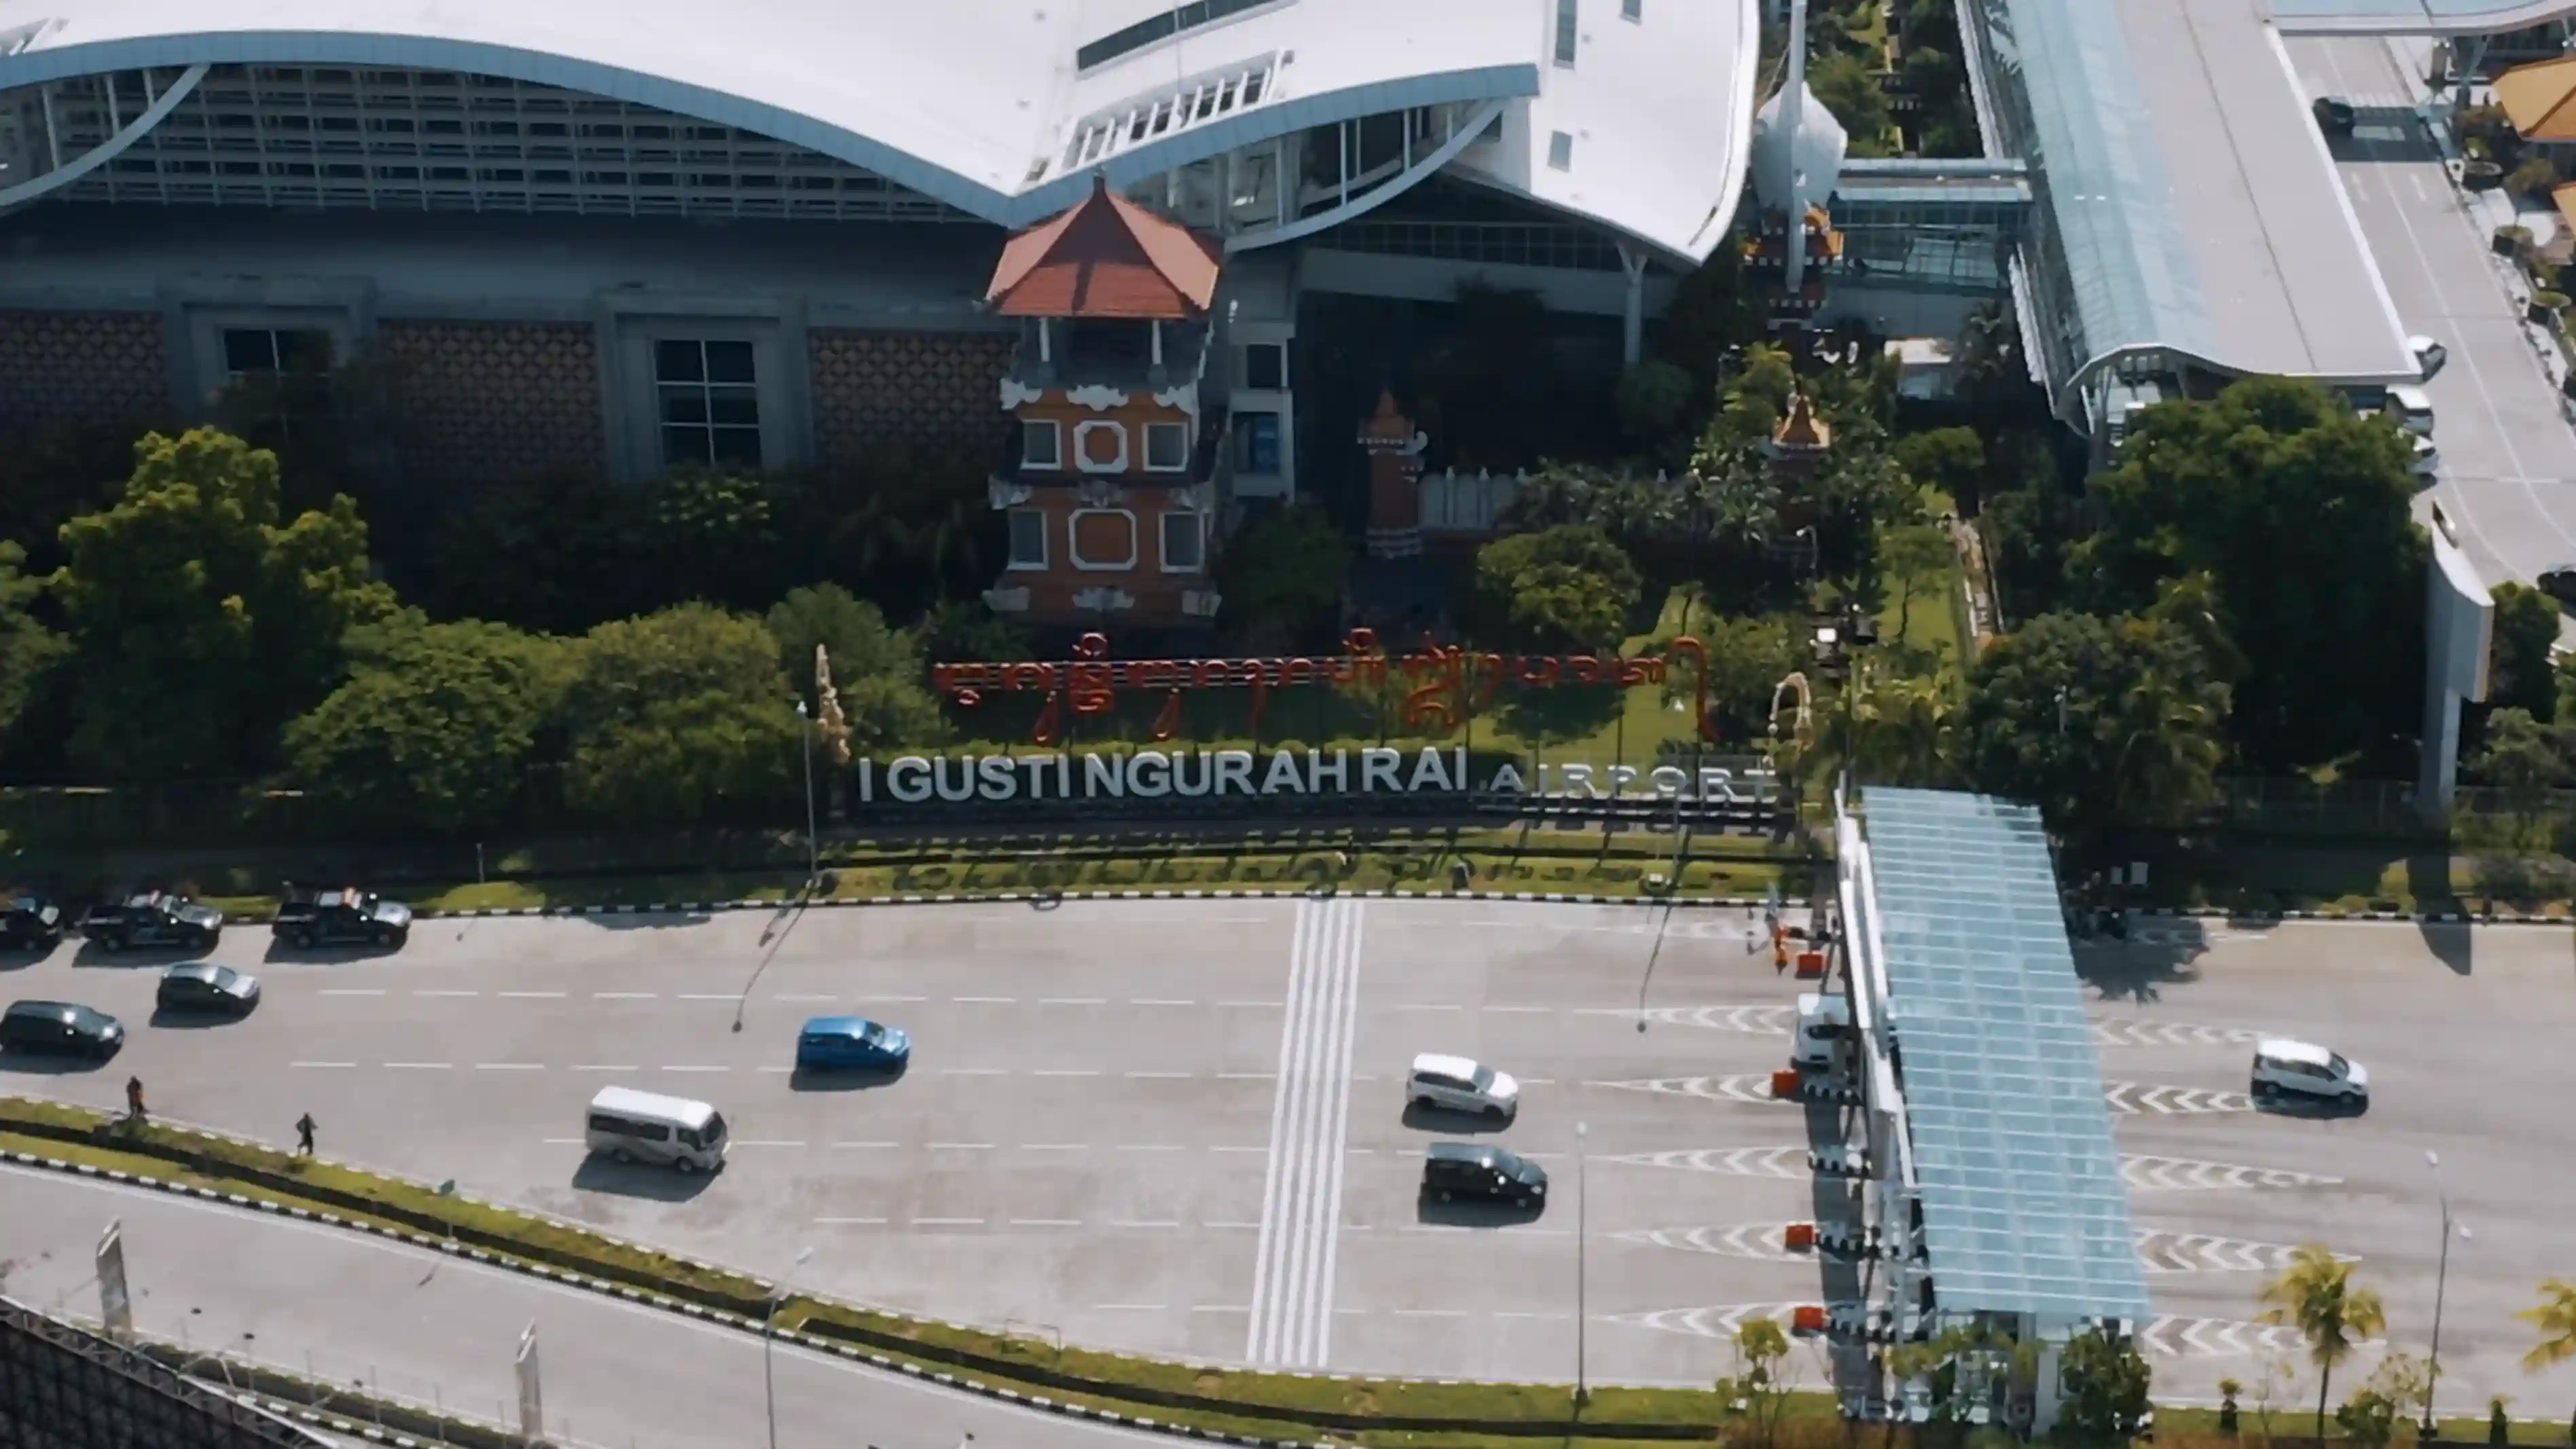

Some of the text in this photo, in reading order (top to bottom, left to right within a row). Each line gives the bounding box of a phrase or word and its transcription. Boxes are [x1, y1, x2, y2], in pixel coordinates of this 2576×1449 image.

[858, 746, 1776, 803] I GUSTI NGURAH RAI AIRPORT
